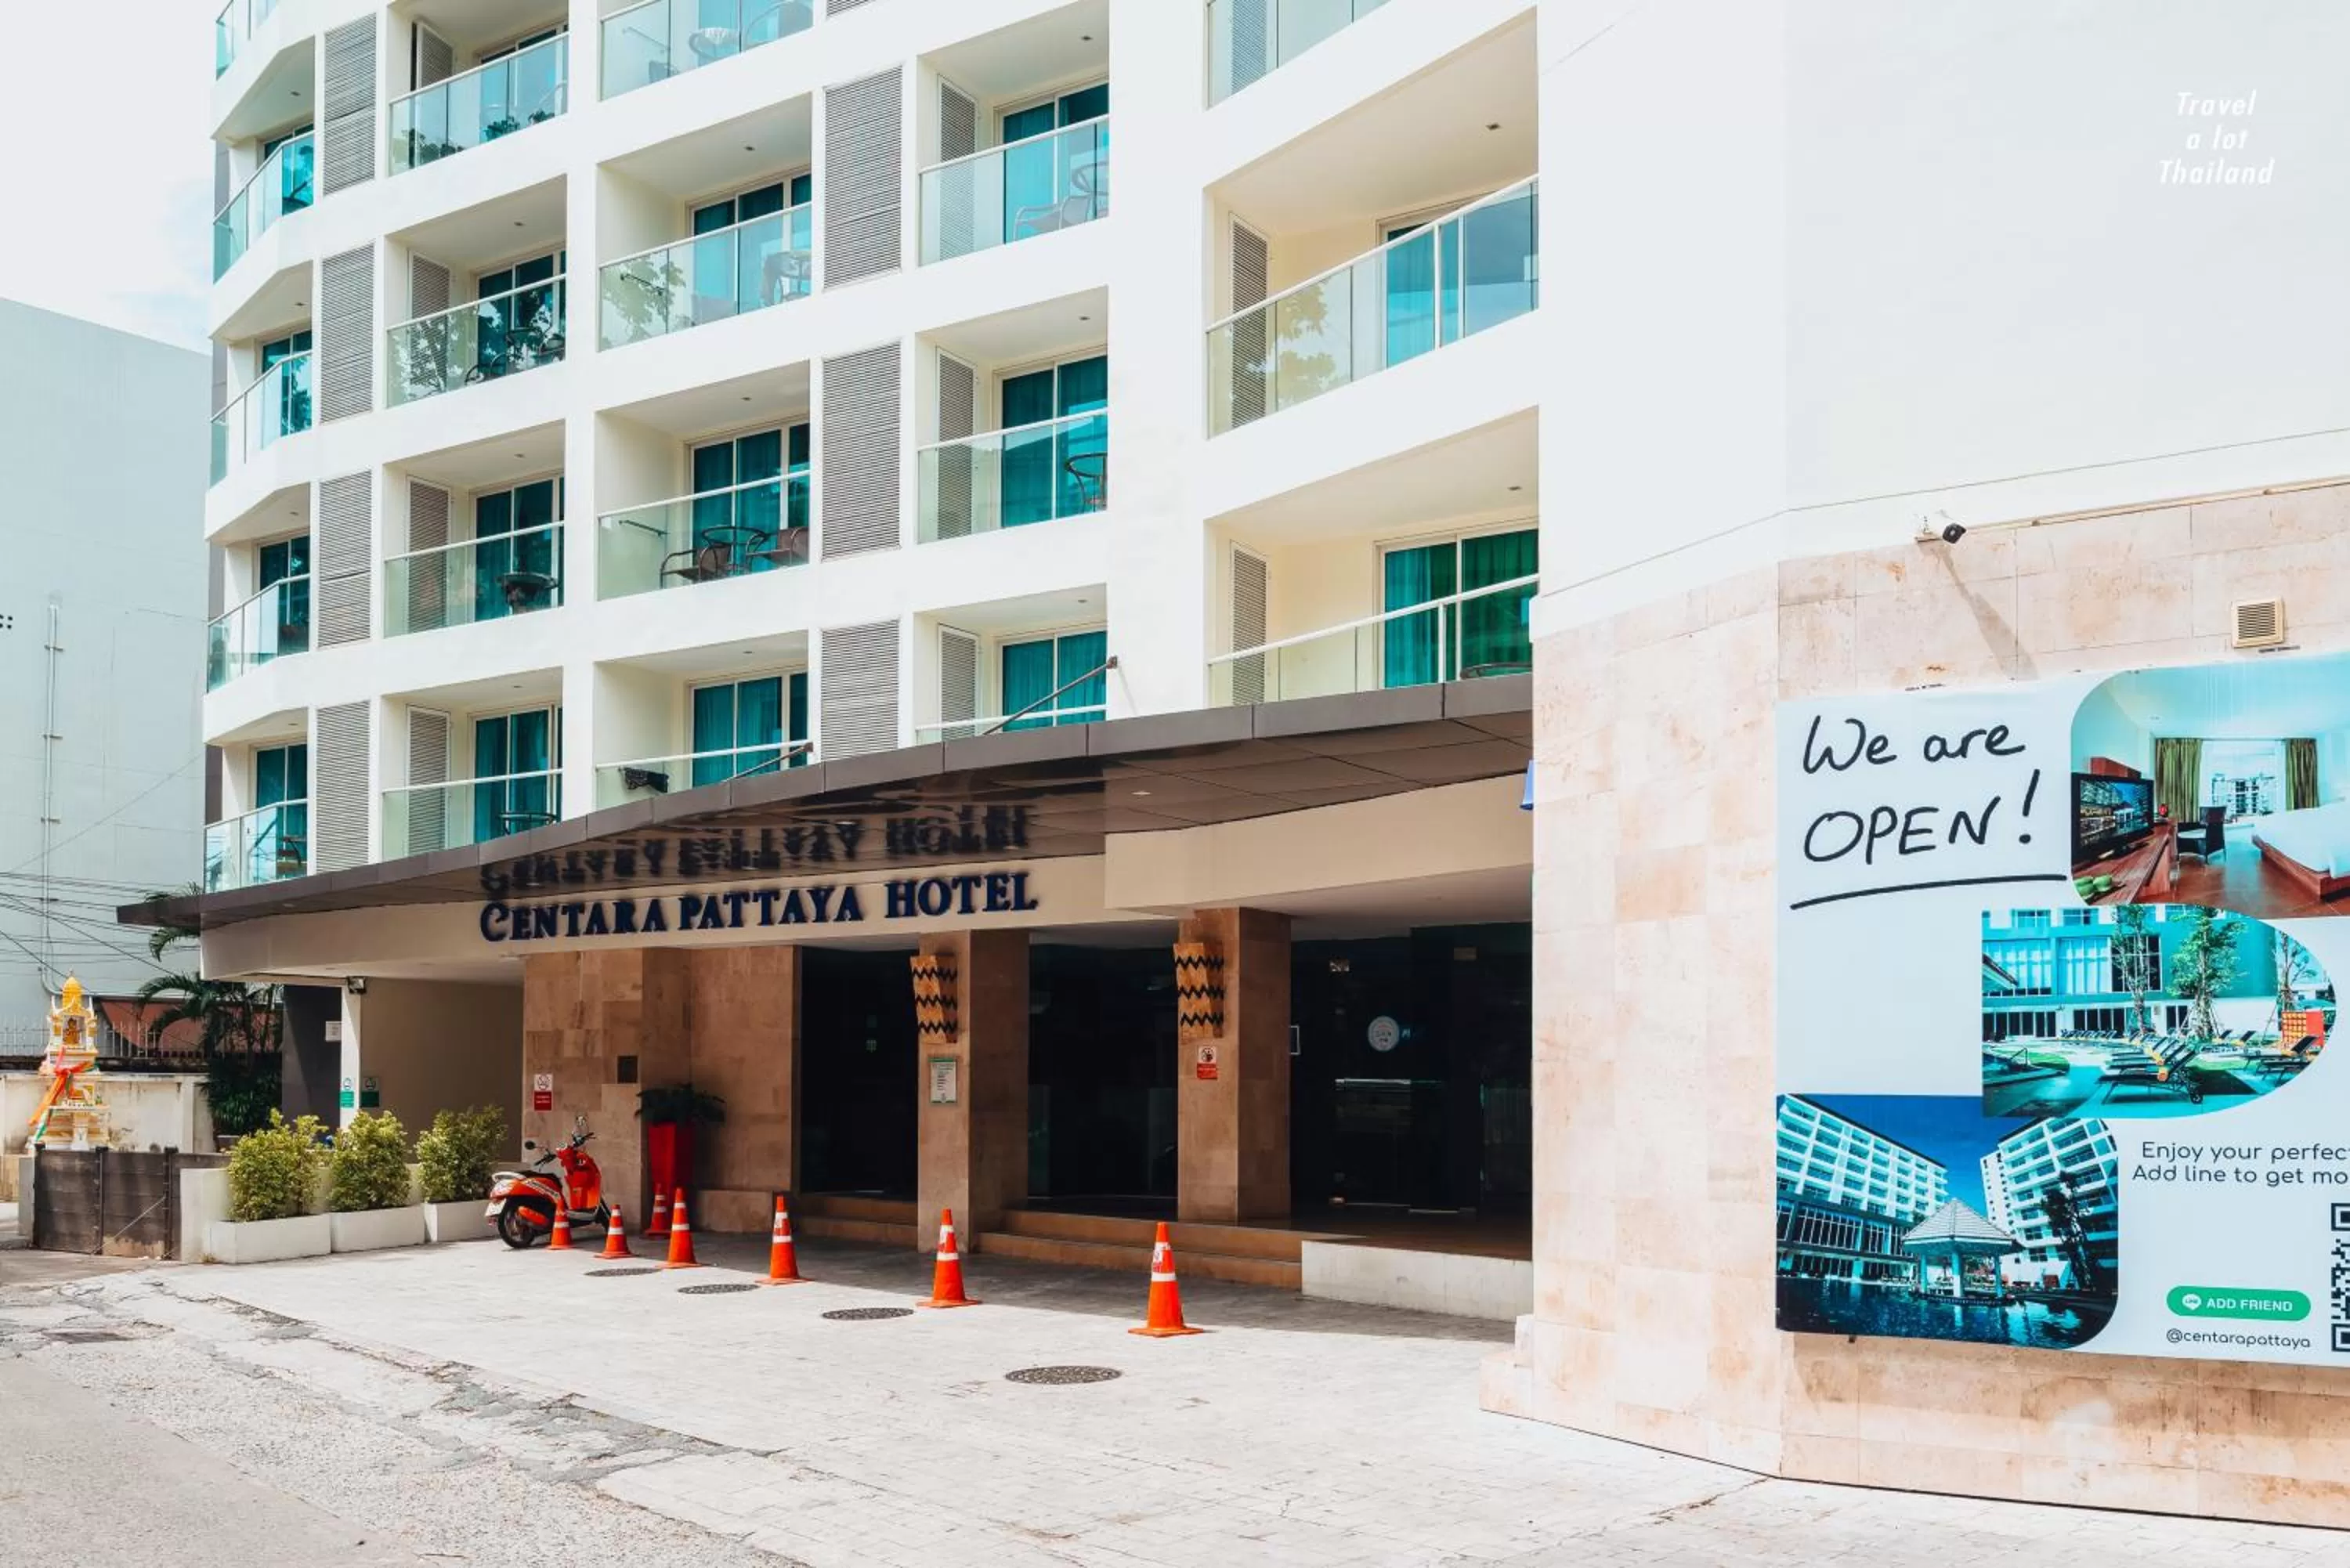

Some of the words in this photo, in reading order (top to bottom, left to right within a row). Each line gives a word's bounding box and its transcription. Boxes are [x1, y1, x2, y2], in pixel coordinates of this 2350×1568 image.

[1803, 714, 1897, 774] We
[1923, 724, 2026, 763] are
[479, 898, 668, 941] CENTARA
[677, 885, 864, 931] PATTAYA
[883, 870, 1039, 919] HOTEL
[2142, 1140, 2204, 1163] Enjoy
[2210, 1146, 2262, 1165] your
[2271, 1143, 2350, 1165] perfec
[2131, 1164, 2177, 1181] Add
[2184, 1164, 2226, 1183] line
[2233, 1167, 2258, 1183] to
[2265, 1168, 2305, 1188] get
[2206, 1297, 2236, 1310] ADD
[2240, 1299, 2294, 1313] FRIEND
[2165, 1327, 2312, 1350] @centarapattaya
